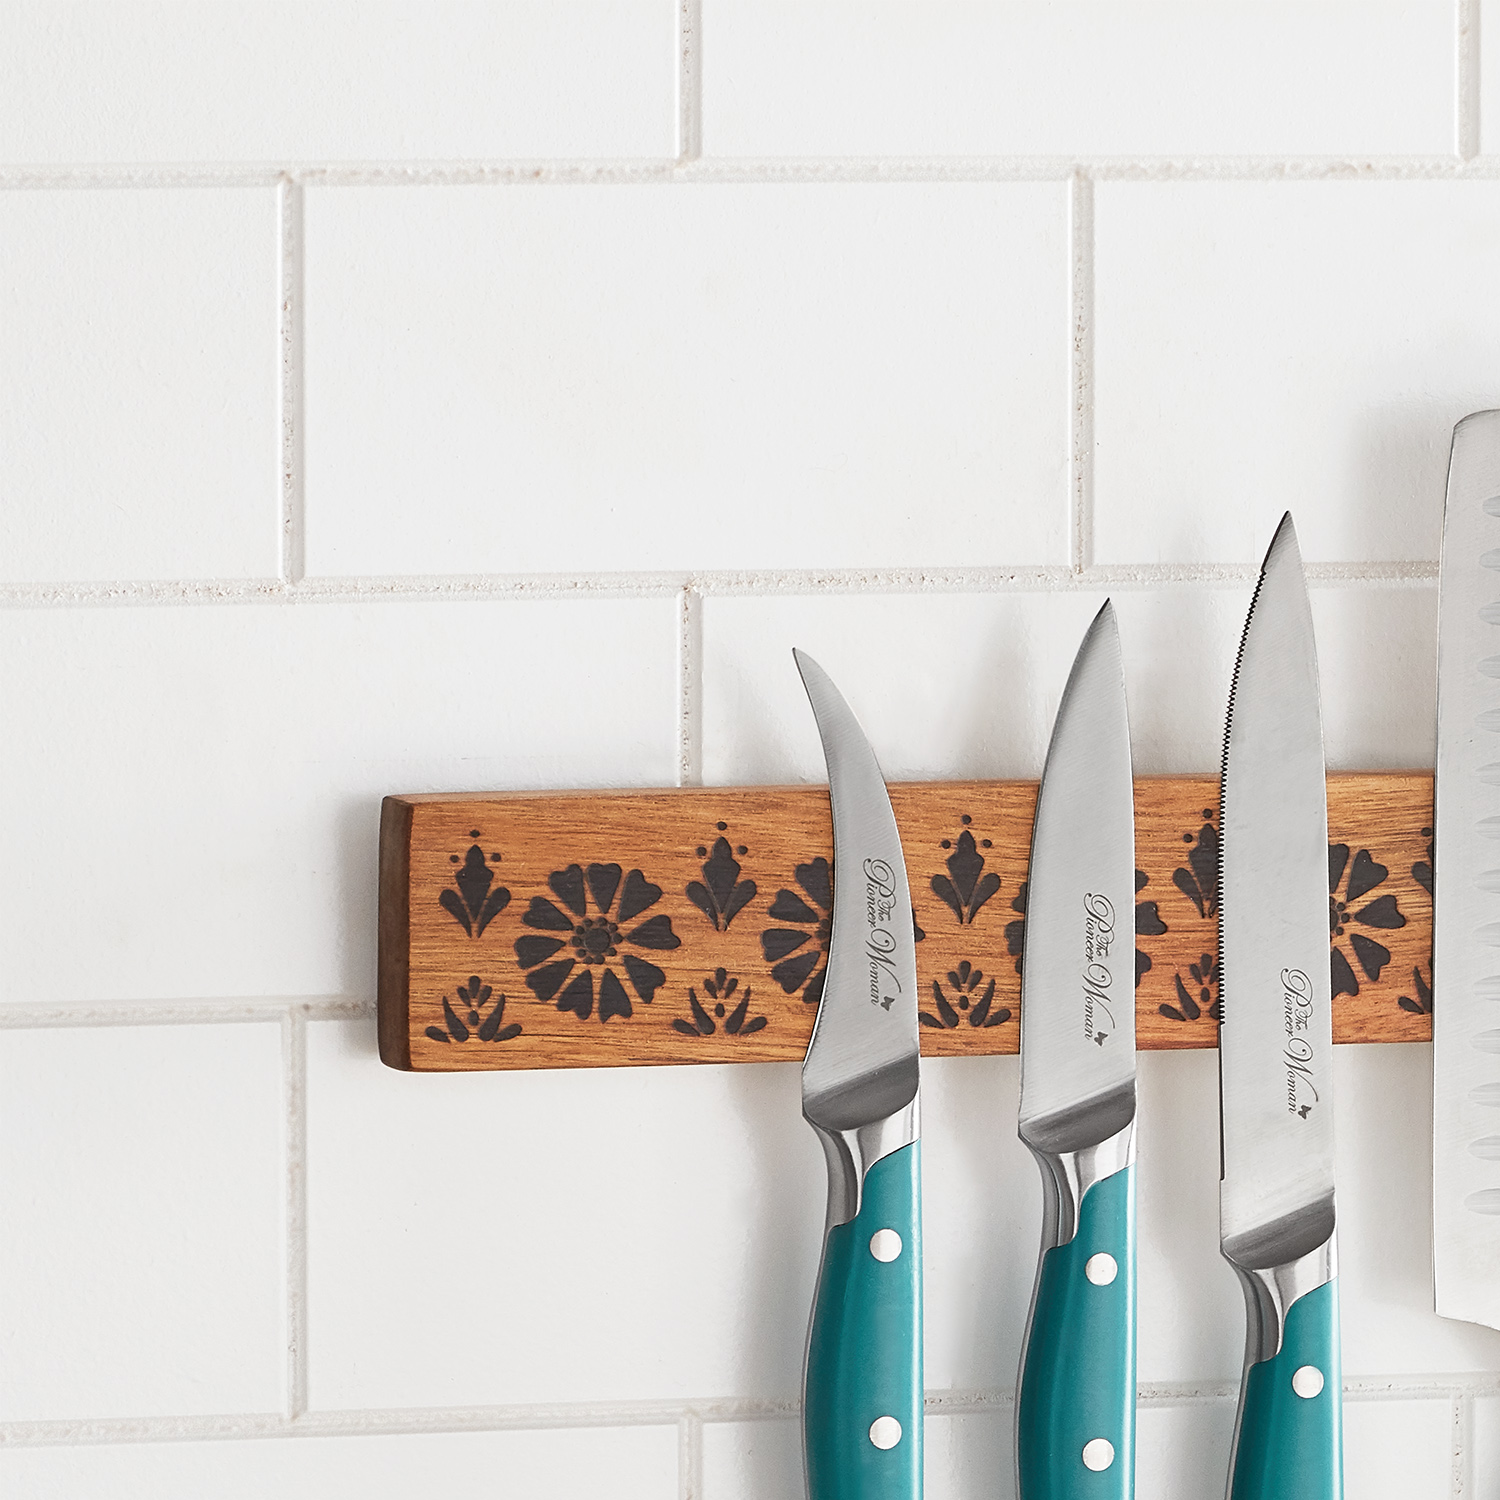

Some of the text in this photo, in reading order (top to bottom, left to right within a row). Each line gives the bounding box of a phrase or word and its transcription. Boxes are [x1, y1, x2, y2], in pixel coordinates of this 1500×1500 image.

[863, 858, 901, 1006] The Pioneer Woman
[1082, 892, 1116, 1041] The Pioneer Woman
[1280, 968, 1319, 1114] The Pioneer Woman
